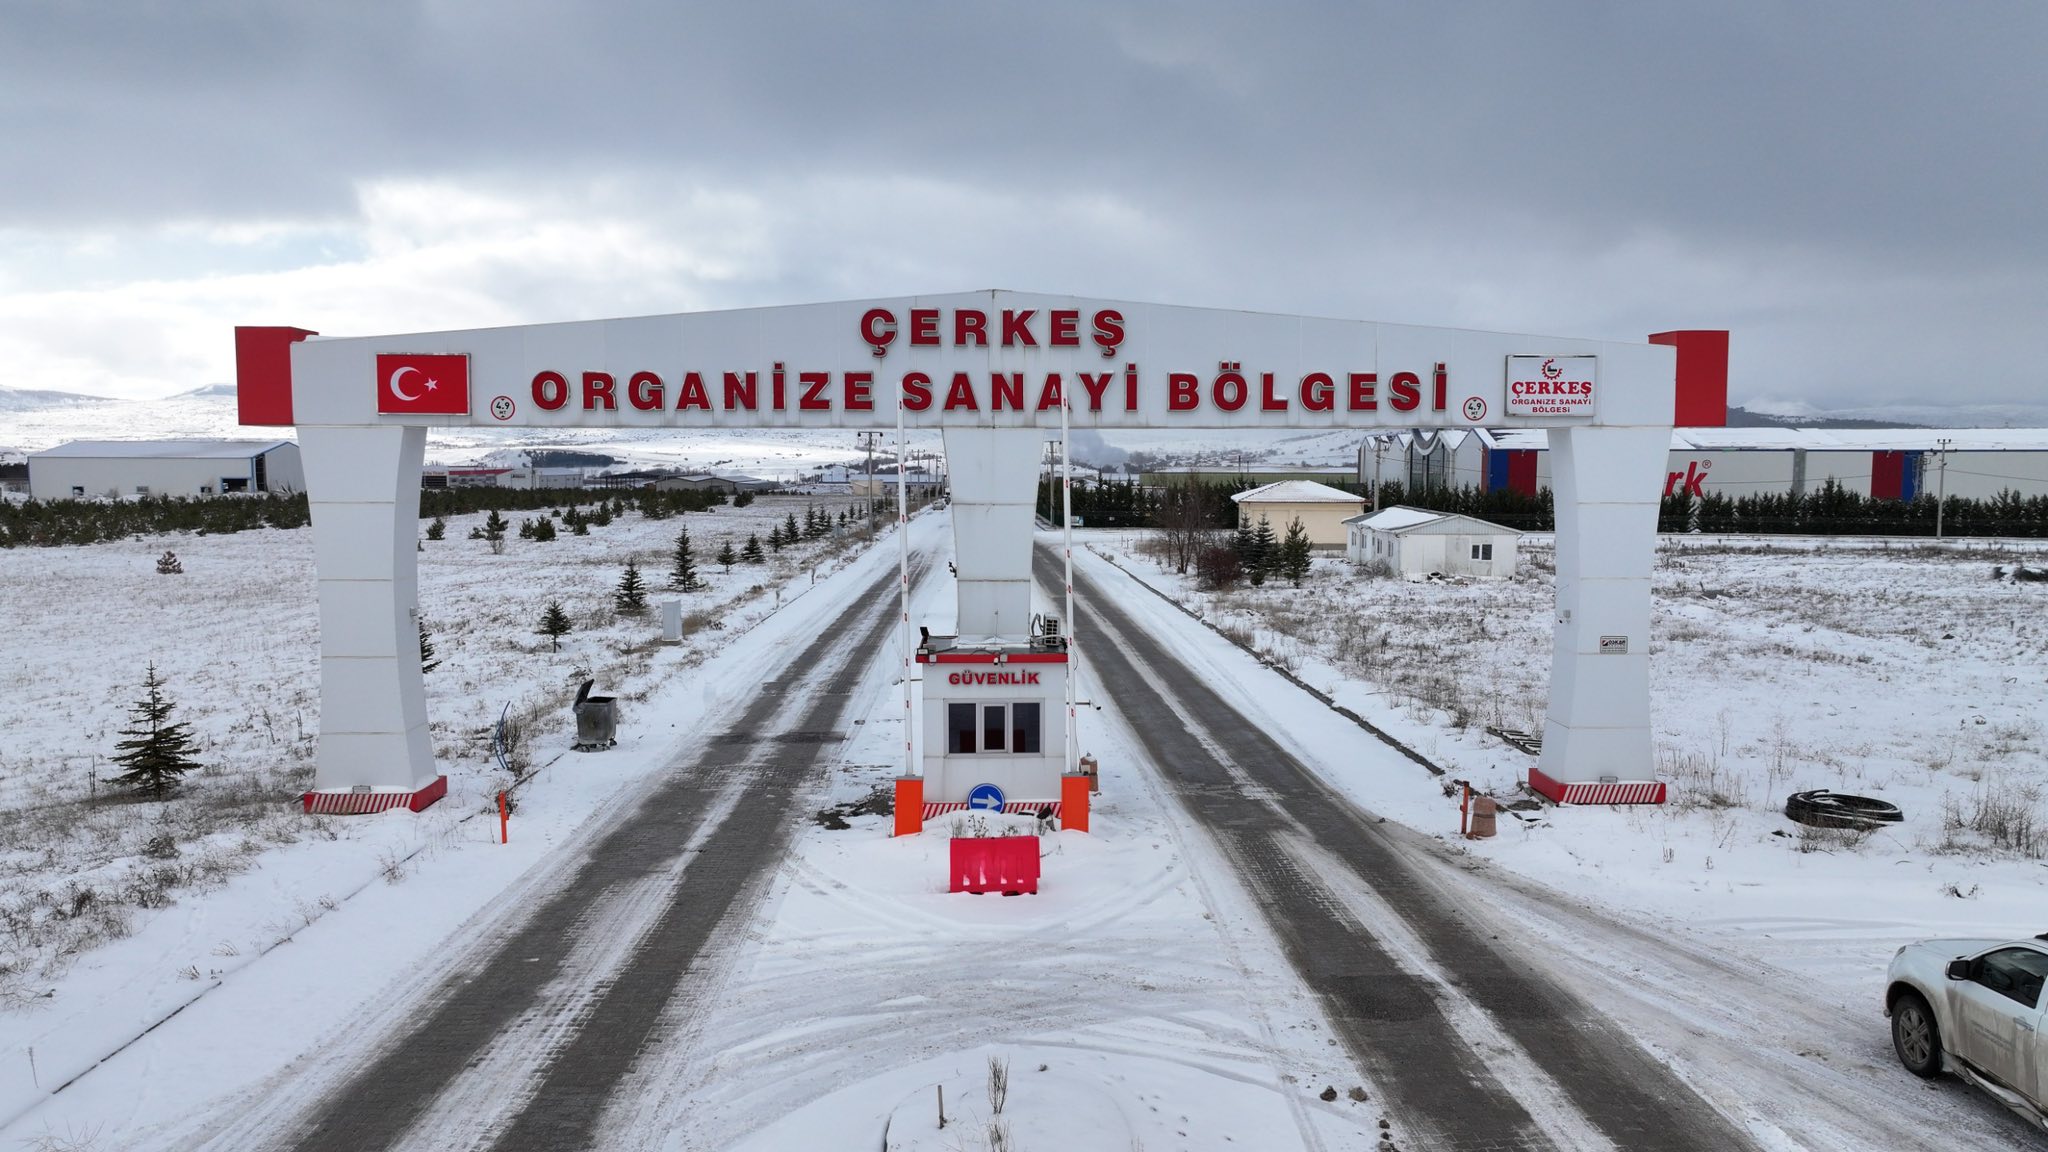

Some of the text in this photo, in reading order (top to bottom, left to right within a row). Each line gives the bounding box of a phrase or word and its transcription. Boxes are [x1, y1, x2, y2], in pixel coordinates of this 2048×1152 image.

[860, 308, 1126, 358] ÇERKEŞ
[530, 360, 1448, 413] ORGANİZE SANAYİ BÖLGESİ
[1511, 381, 1592, 398] ÇERKEŞ
[496, 401, 510, 410] 4.9
[1468, 402, 1482, 411] 4.9
[948, 669, 1040, 685] GÜVENLİK
